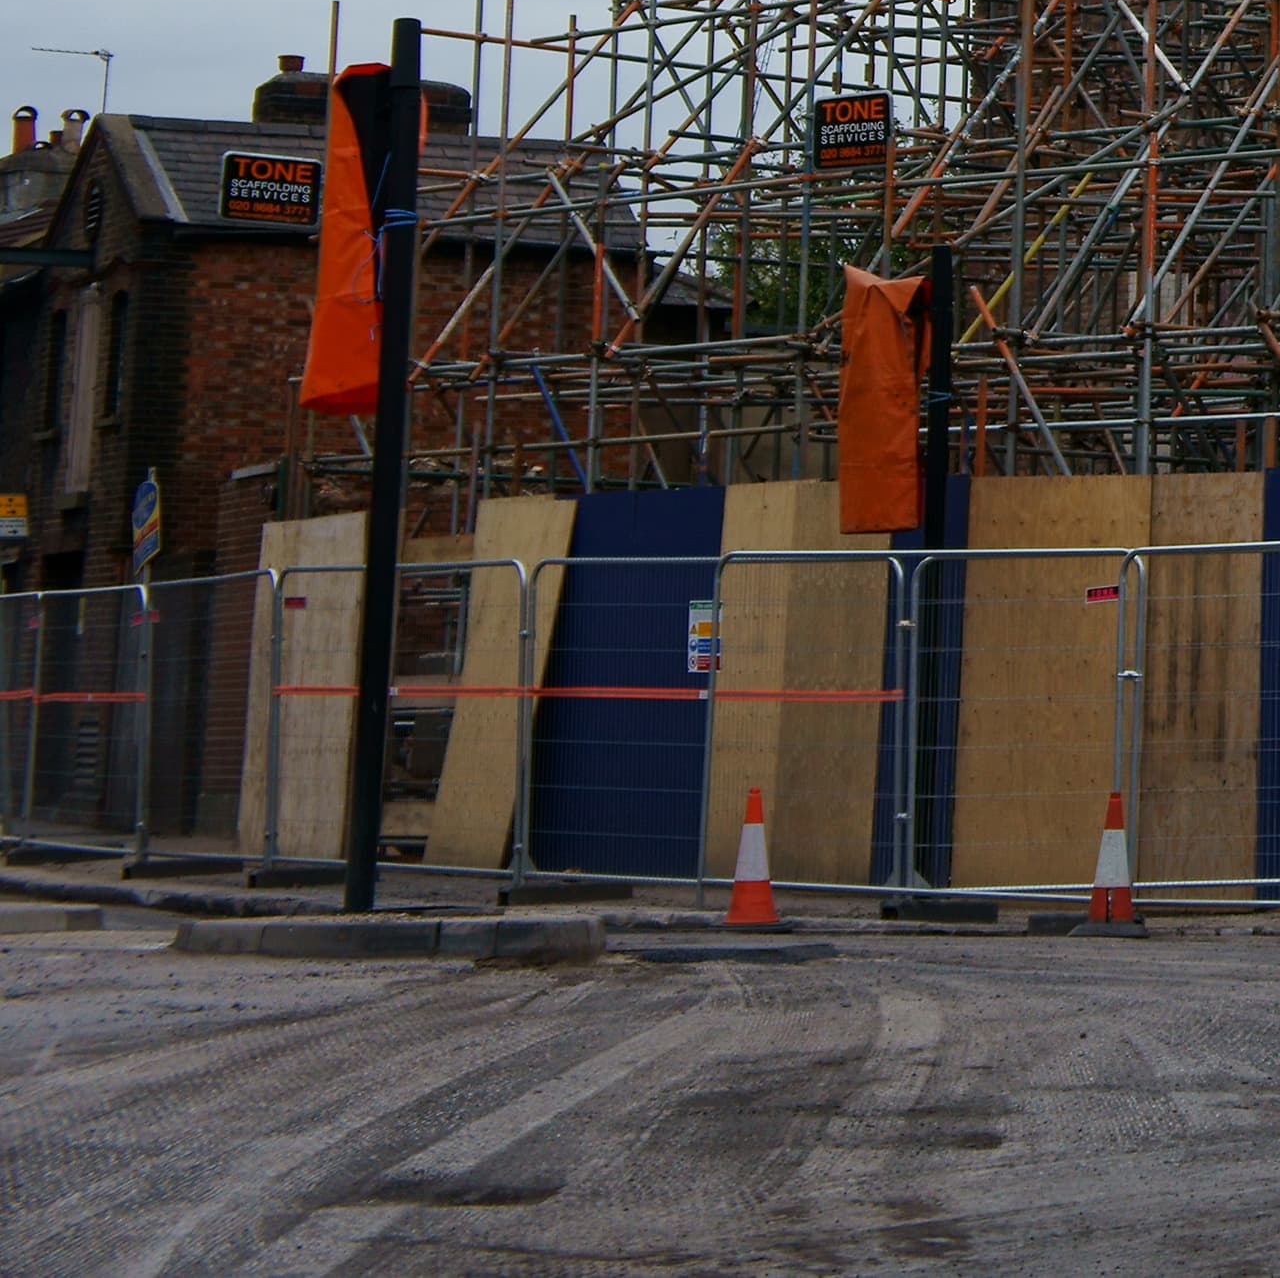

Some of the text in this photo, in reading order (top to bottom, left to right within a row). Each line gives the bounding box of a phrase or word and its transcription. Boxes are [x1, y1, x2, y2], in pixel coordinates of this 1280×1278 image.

[822, 97, 885, 123] TONE
[821, 121, 885, 135] SCAFFOLDING
[821, 131, 884, 145] SERVICES
[233, 158, 314, 183] TONE
[231, 178, 311, 195] SCAFFOLDING
[230, 187, 310, 203] SERVICES
